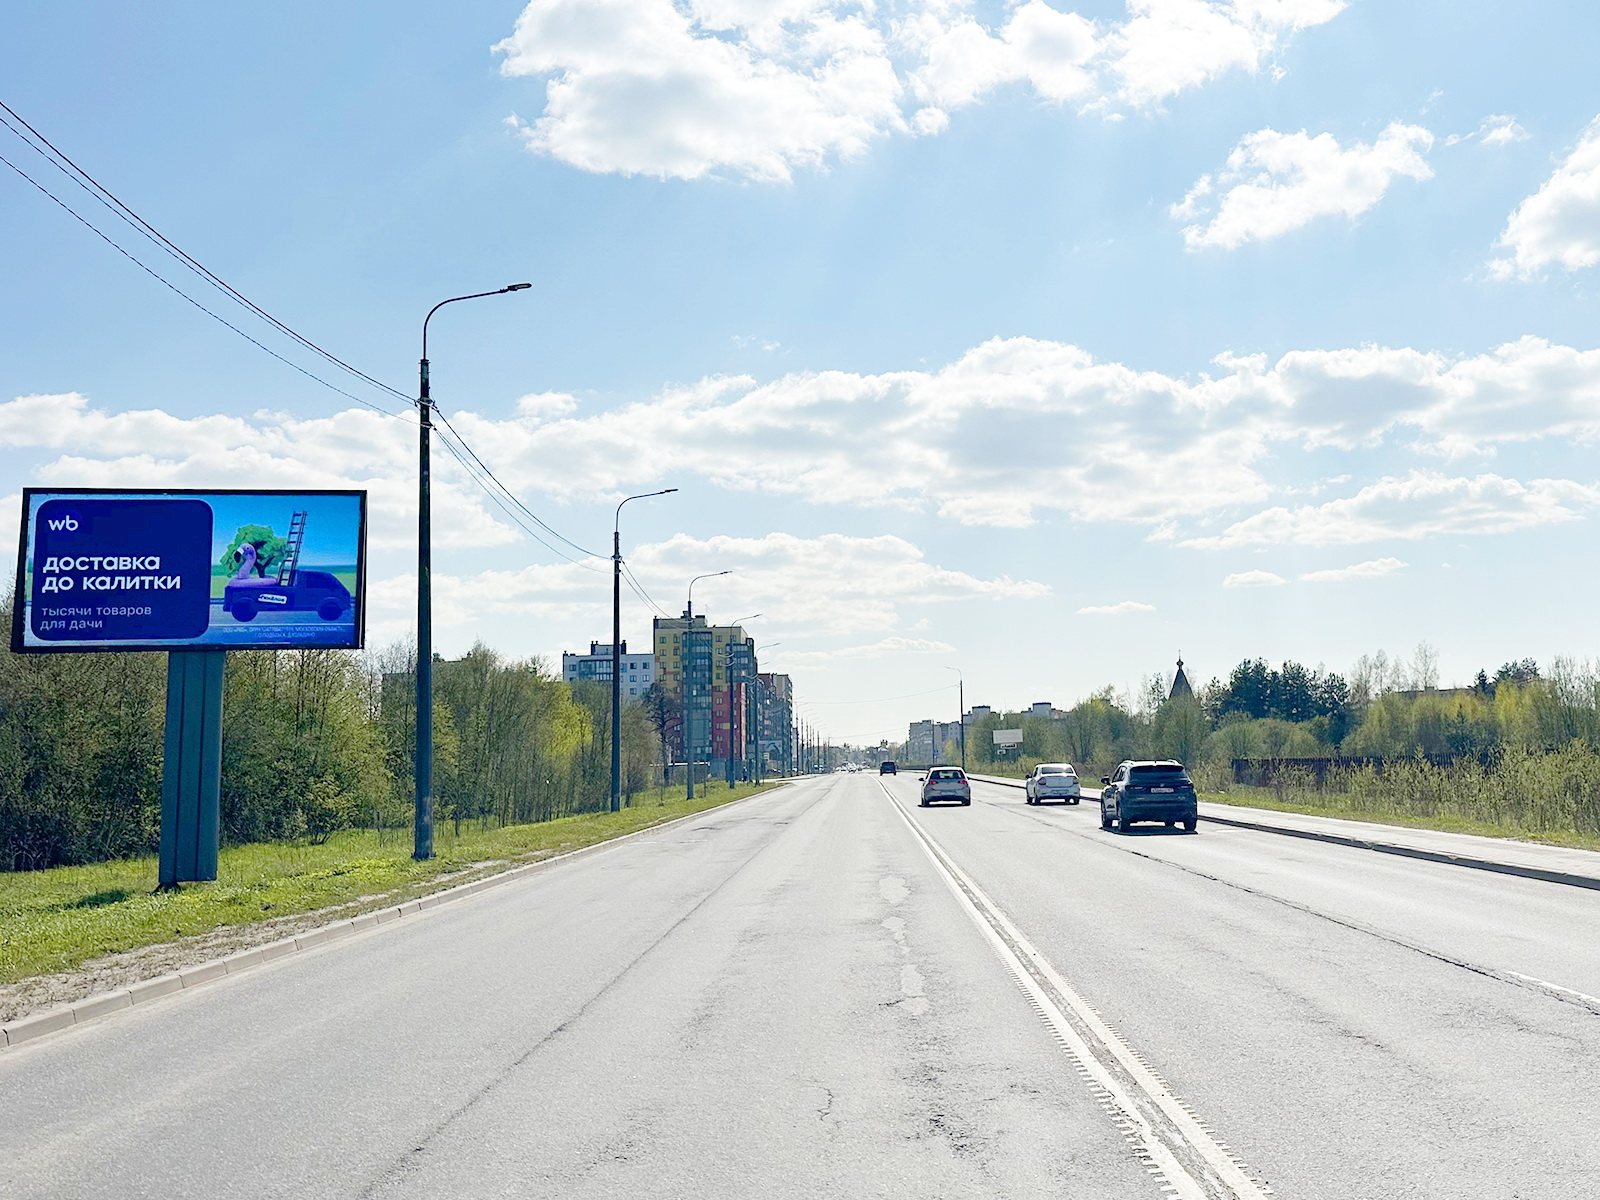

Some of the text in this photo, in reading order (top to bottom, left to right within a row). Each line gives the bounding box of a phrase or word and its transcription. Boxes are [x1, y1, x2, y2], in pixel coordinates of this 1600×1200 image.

[48, 515, 78, 531] wb
[43, 556, 160, 573] доставка
[42, 576, 181, 593] до калитки
[42, 605, 152, 617] тысячи товаров
[40, 618, 103, 630] для дачи
